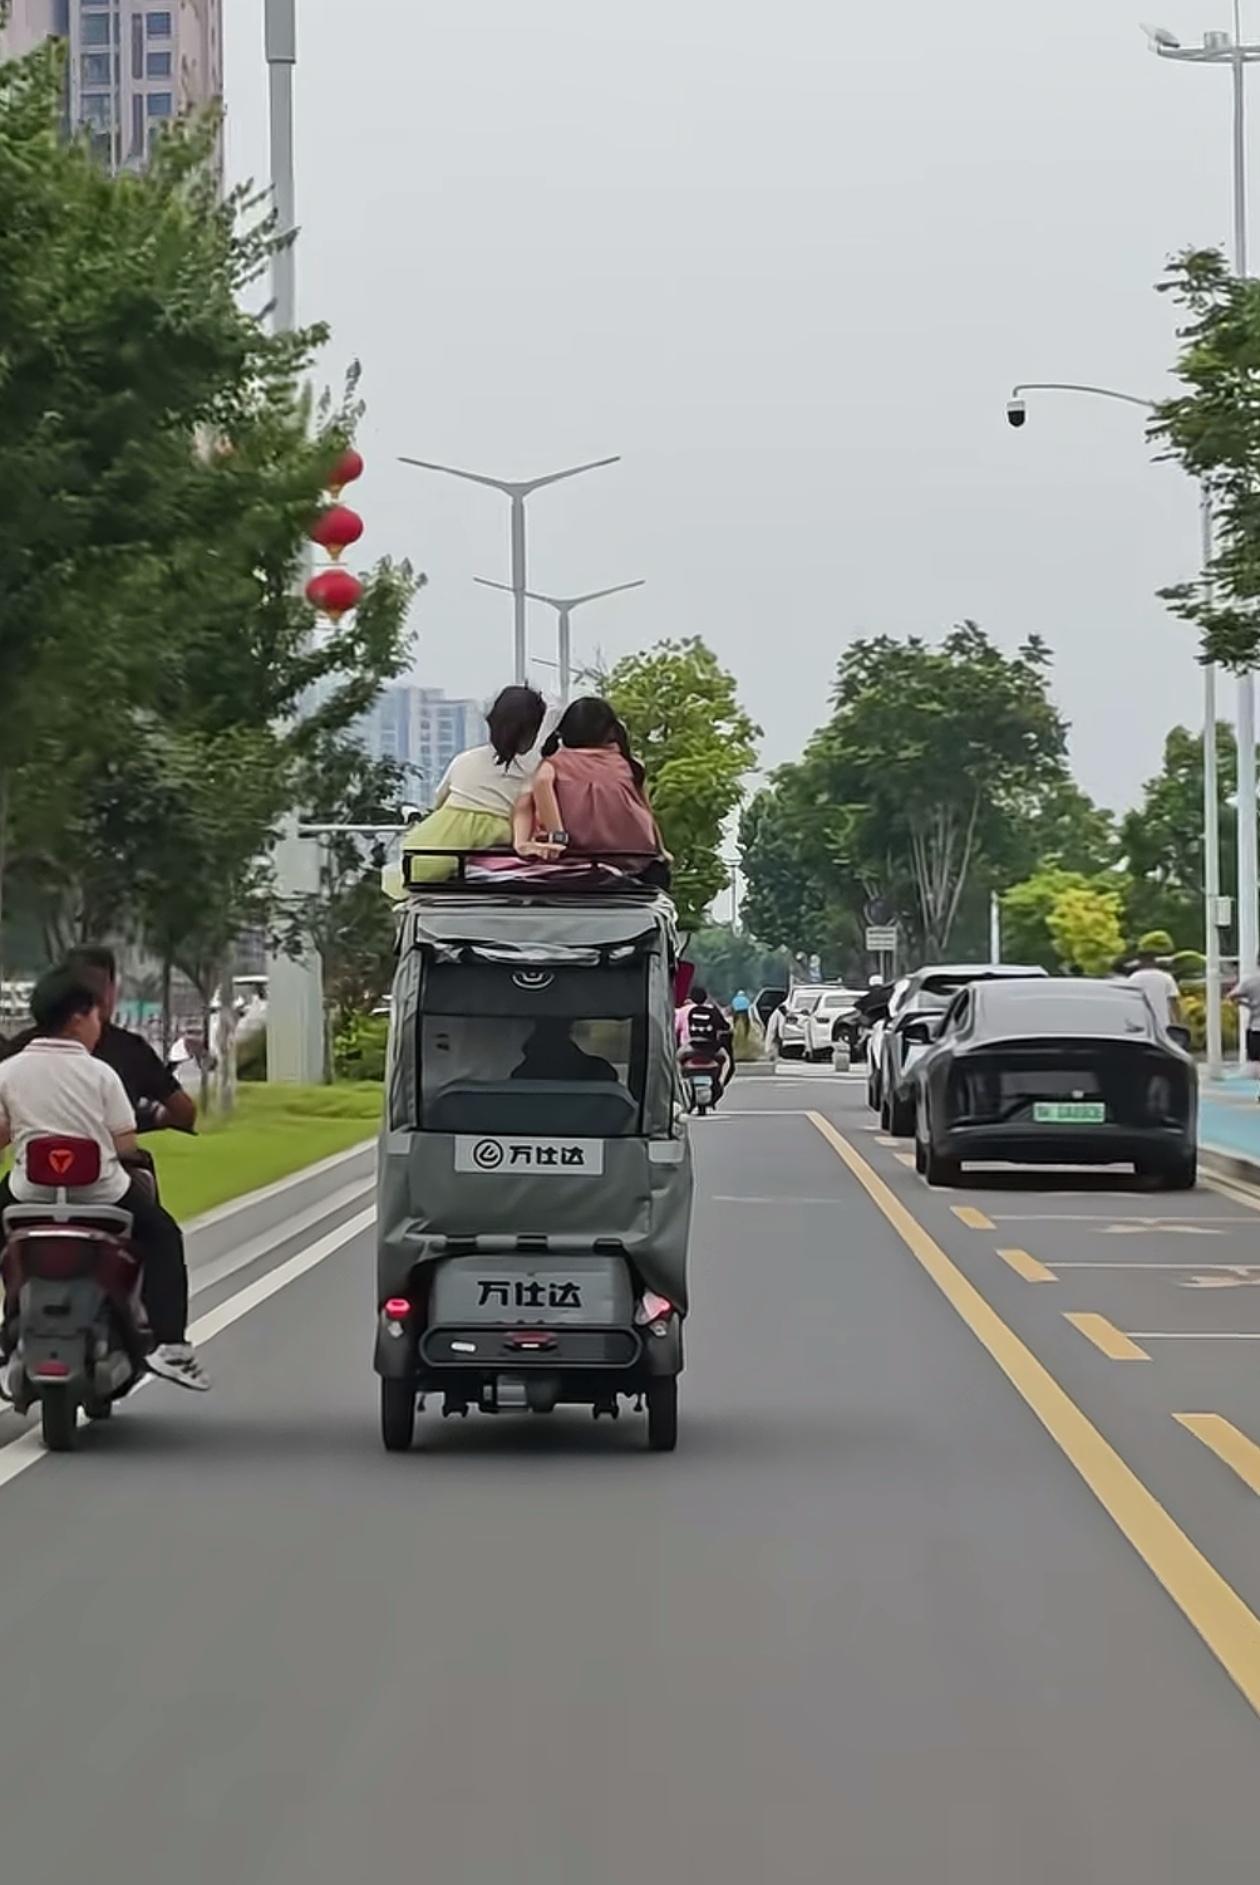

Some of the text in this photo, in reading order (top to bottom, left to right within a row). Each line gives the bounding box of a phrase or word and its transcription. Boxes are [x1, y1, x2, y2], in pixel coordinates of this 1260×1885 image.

[509, 1145, 585, 1166] 万仕达
[477, 1281, 582, 1309] 万仕达
